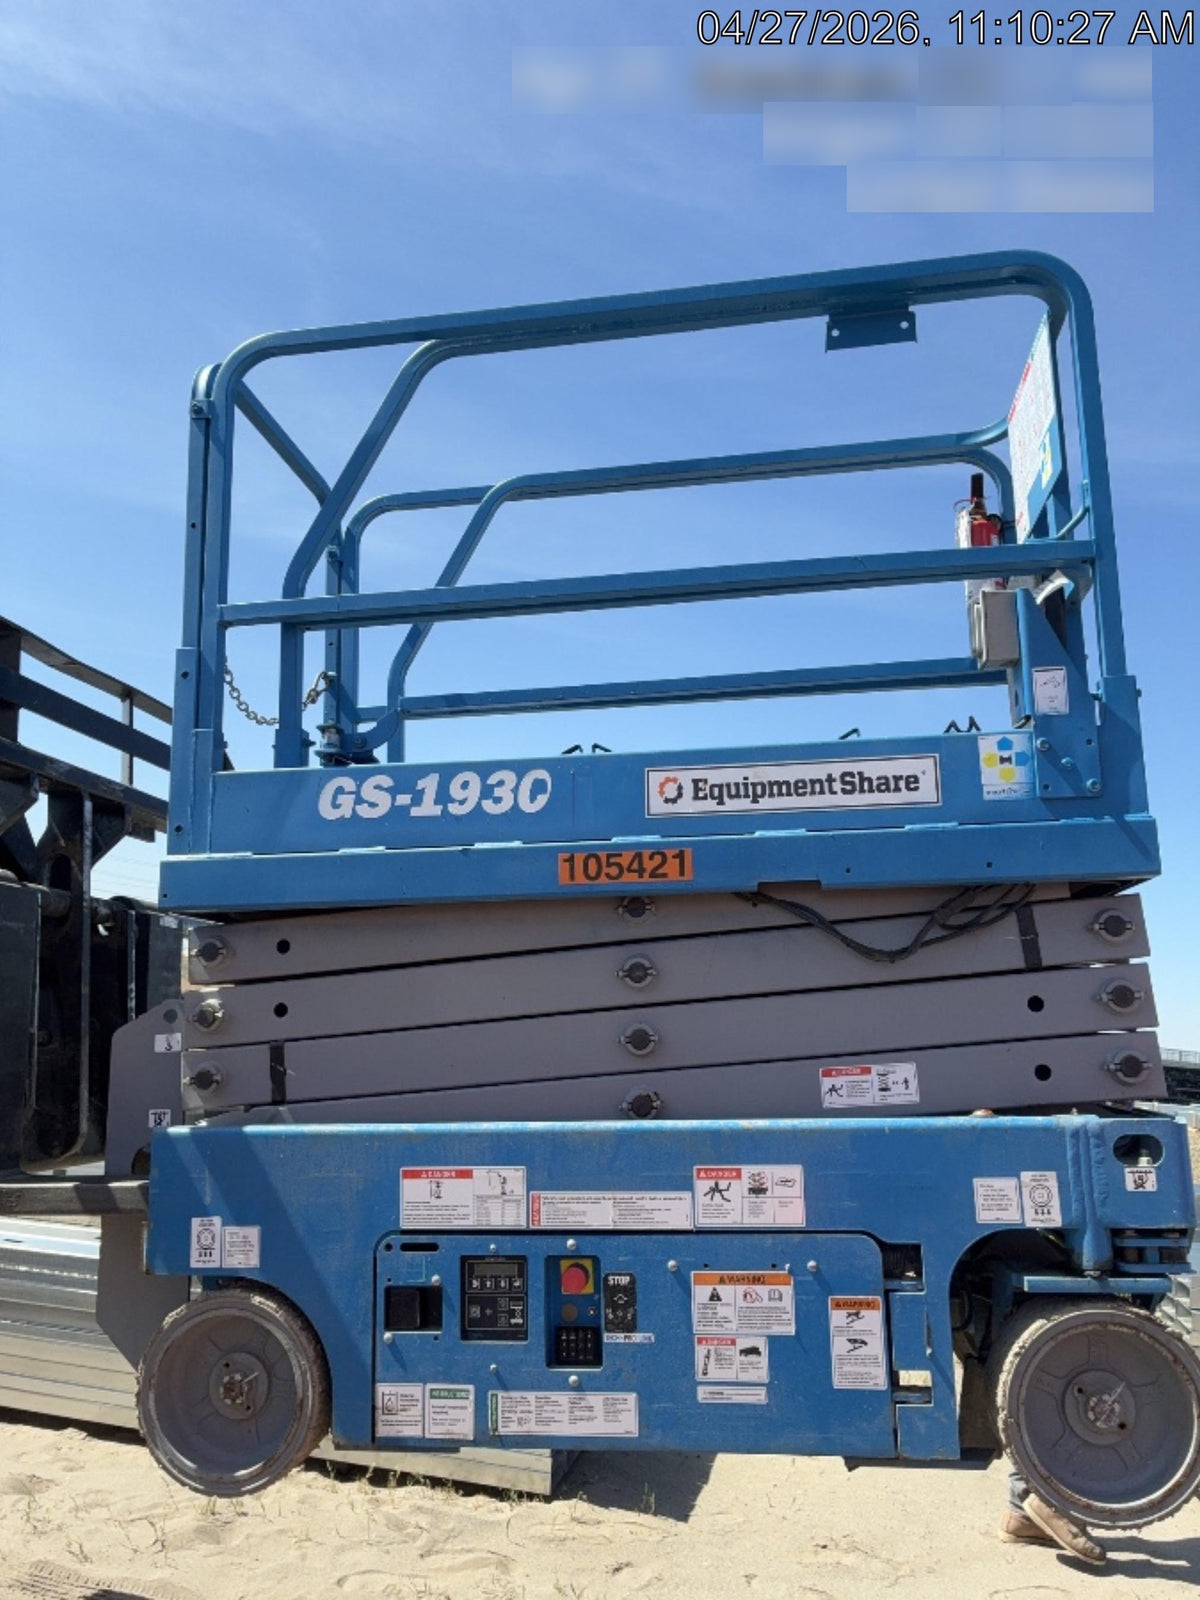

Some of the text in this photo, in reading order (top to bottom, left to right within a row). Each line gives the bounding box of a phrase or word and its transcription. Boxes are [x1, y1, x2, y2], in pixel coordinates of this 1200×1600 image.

[317, 768, 552, 821] GS-1930
[691, 770, 921, 806] EquipmentShare
[562, 849, 690, 883] 105421
[607, 1275, 631, 1286] STOP
